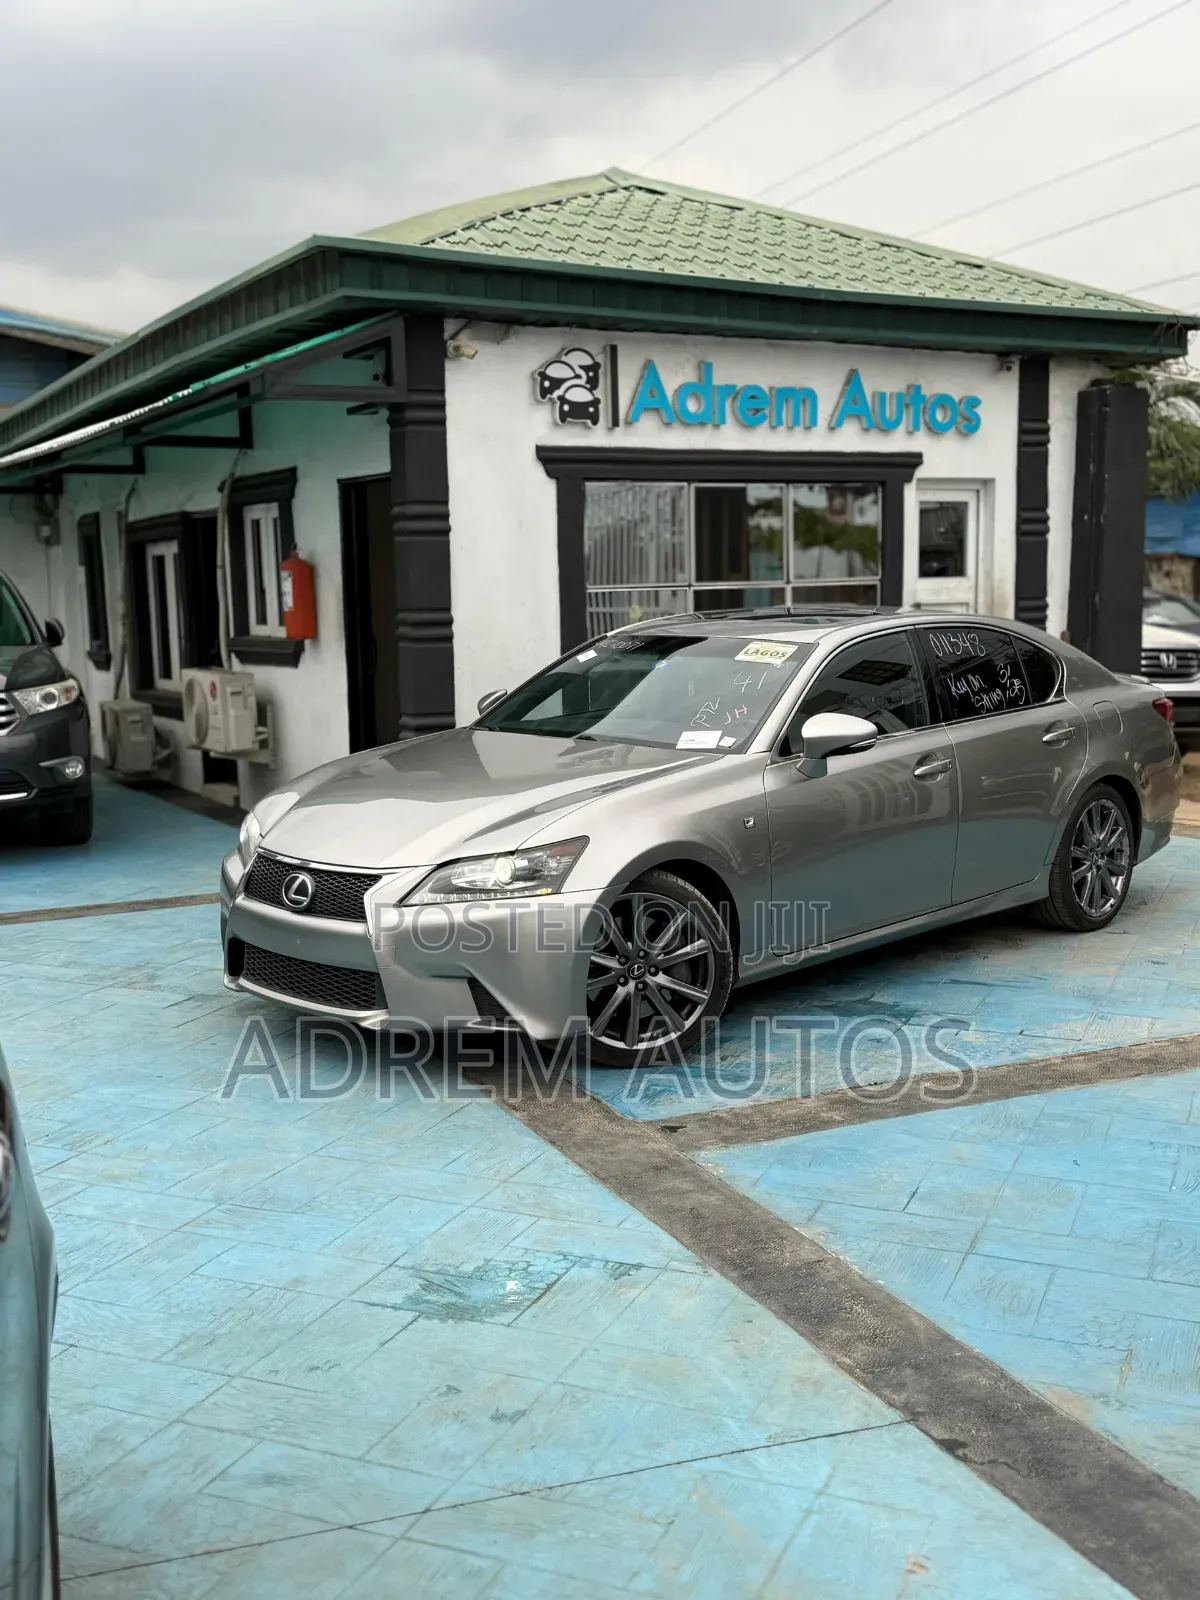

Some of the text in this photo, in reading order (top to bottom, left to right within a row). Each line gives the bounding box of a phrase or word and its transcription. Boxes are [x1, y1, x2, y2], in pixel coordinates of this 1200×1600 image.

[627, 359, 983, 436] Adrem Autos
[743, 647, 789, 659] LAGOS
